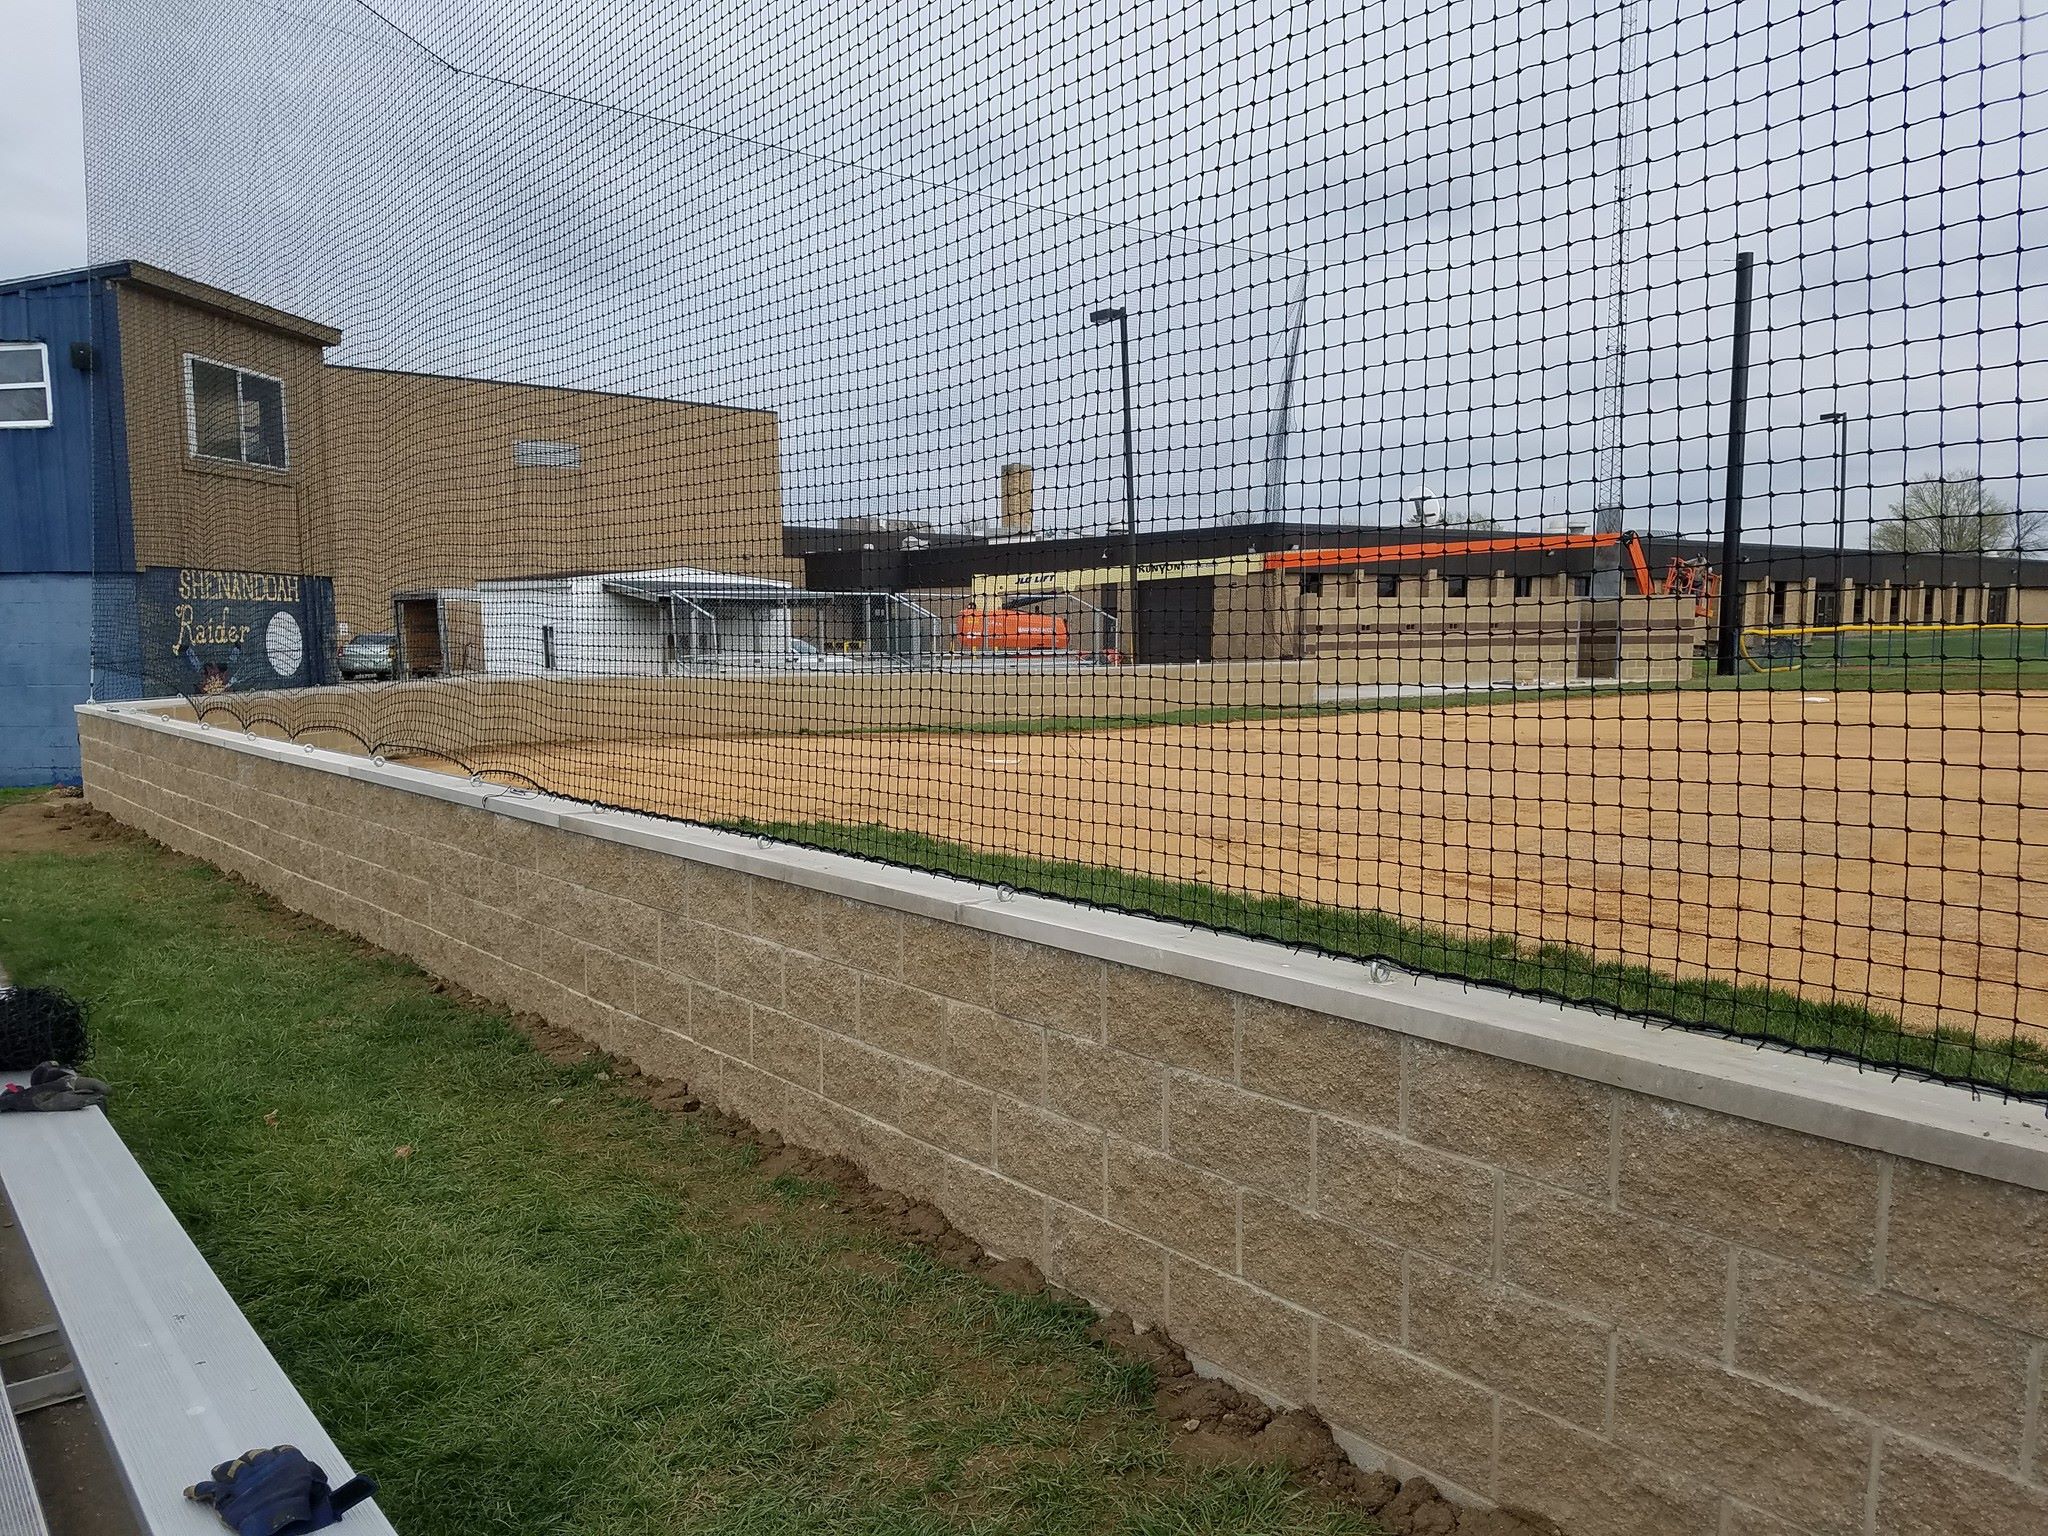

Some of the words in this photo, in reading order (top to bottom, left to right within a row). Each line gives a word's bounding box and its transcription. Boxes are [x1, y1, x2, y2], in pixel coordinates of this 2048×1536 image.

[1015, 576, 1032, 585] JLG
[1034, 574, 1055, 583] LIFT
[1138, 563, 1181, 574] RUNYON
[178, 569, 301, 602] SHENANDOAH
[172, 604, 251, 656] Raider
